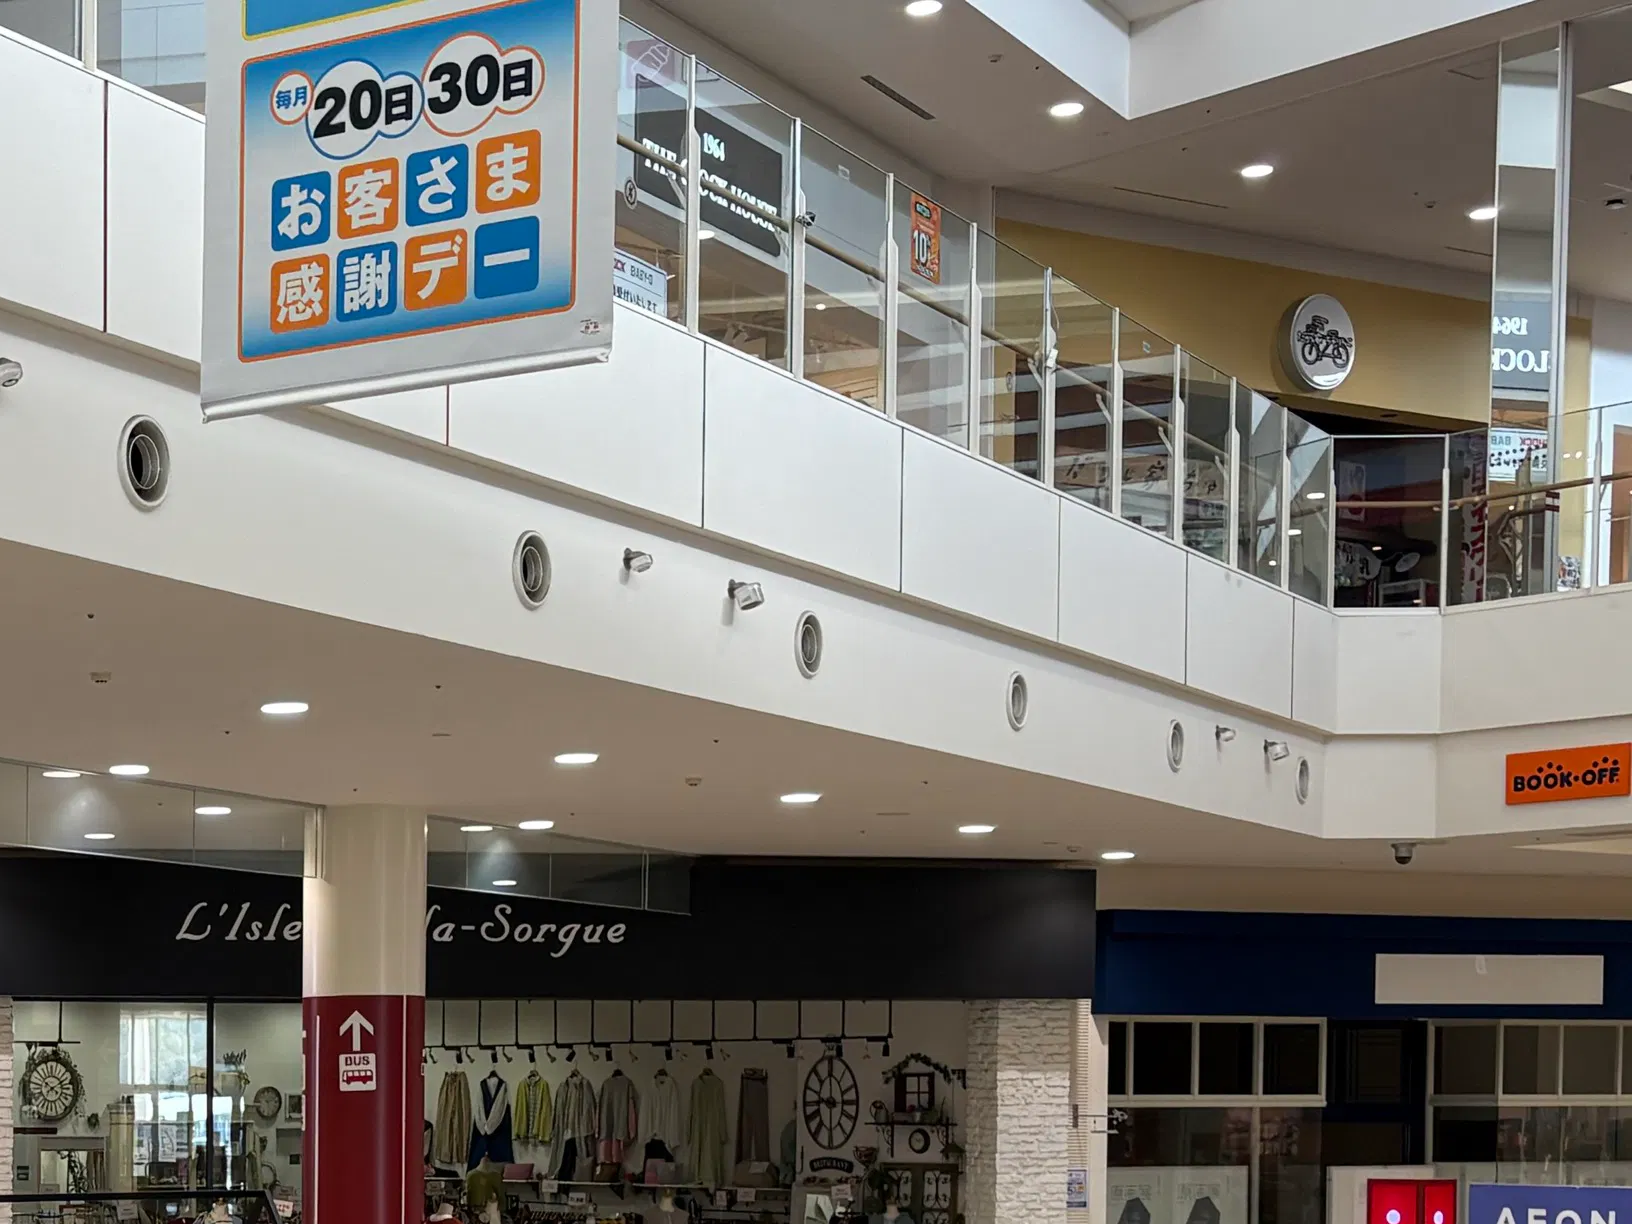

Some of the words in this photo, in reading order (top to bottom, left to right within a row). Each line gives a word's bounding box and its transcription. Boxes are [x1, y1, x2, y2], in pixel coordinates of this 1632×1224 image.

[275, 84, 308, 110] 毎月
[313, 79, 414, 139] 20日
[427, 54, 534, 115] 30日
[277, 142, 531, 240] お客さま
[276, 234, 531, 324] 感謝デー
[344, 1056, 370, 1067] BUS
